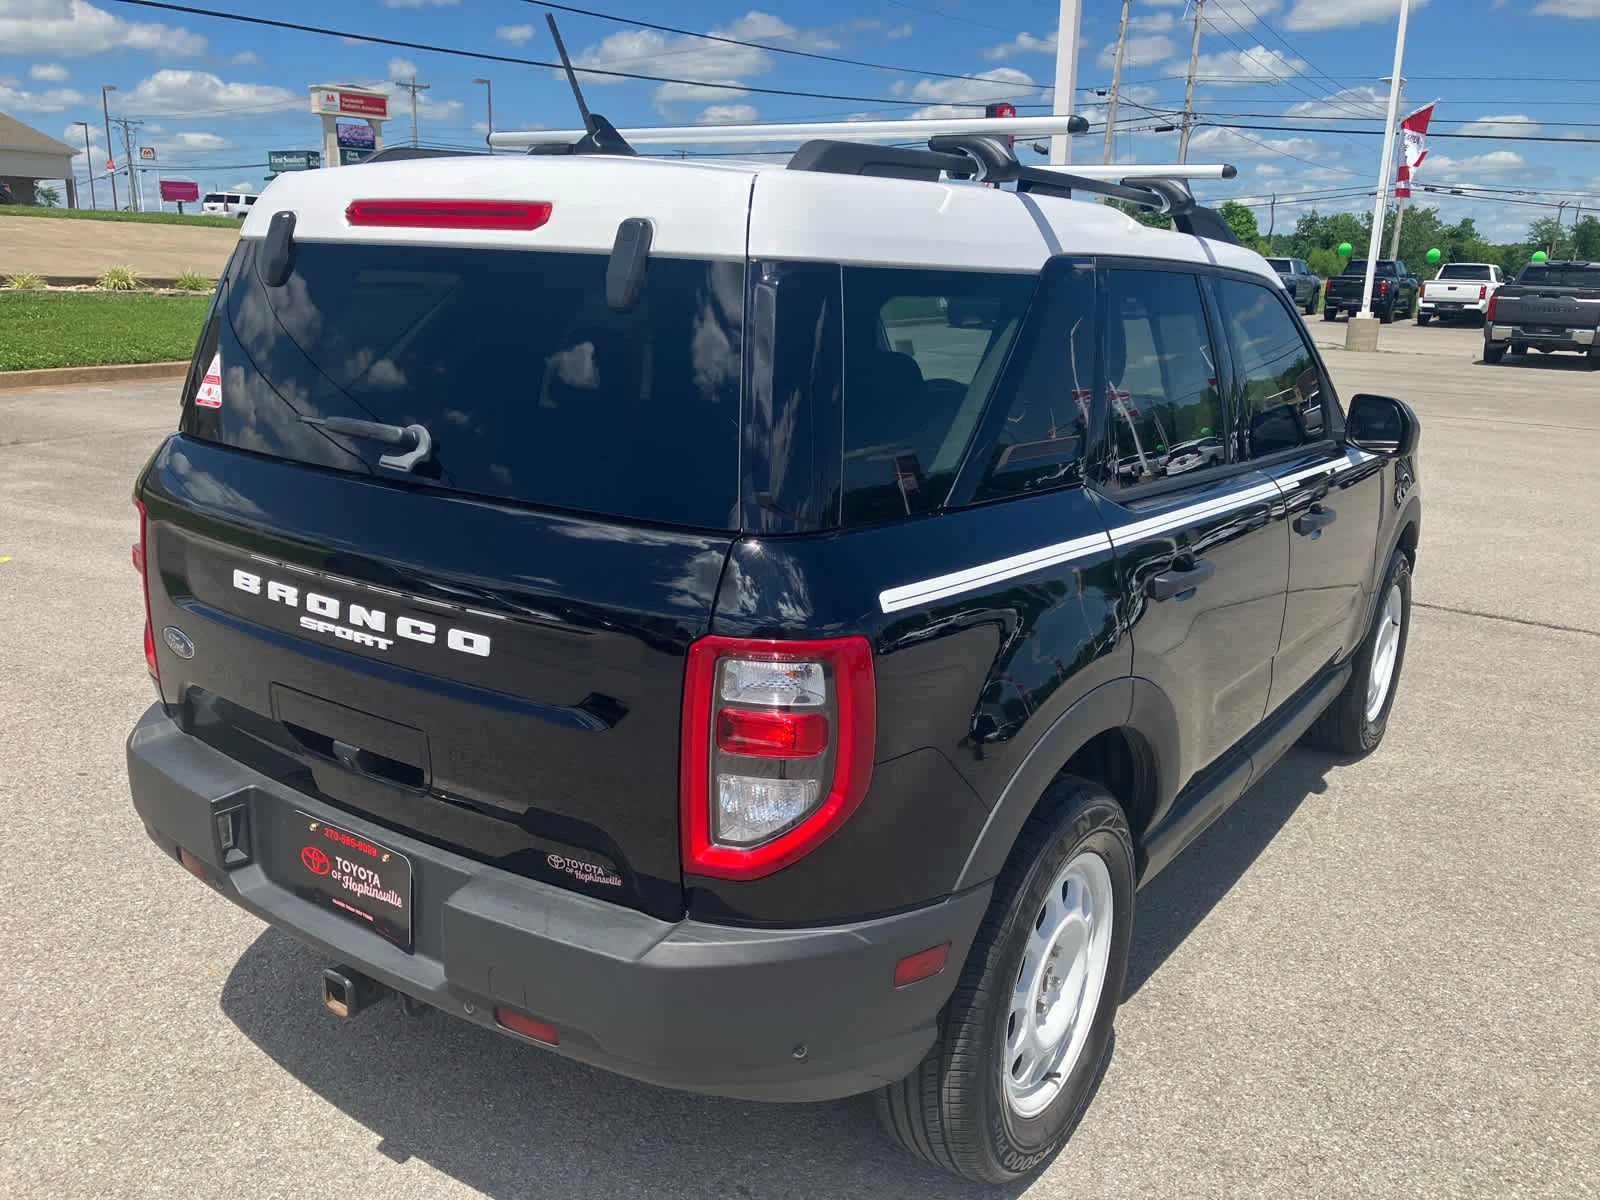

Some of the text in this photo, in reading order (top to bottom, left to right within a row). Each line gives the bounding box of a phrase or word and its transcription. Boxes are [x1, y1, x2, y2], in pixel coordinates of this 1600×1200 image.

[233, 569, 491, 656] BRONCO
[299, 616, 394, 650] SPORT
[335, 856, 381, 888] TOYOTA
[564, 857, 604, 876] TOYOTA
[574, 870, 622, 886] Hopkinsville
[342, 875, 403, 908] Hopkinsville
